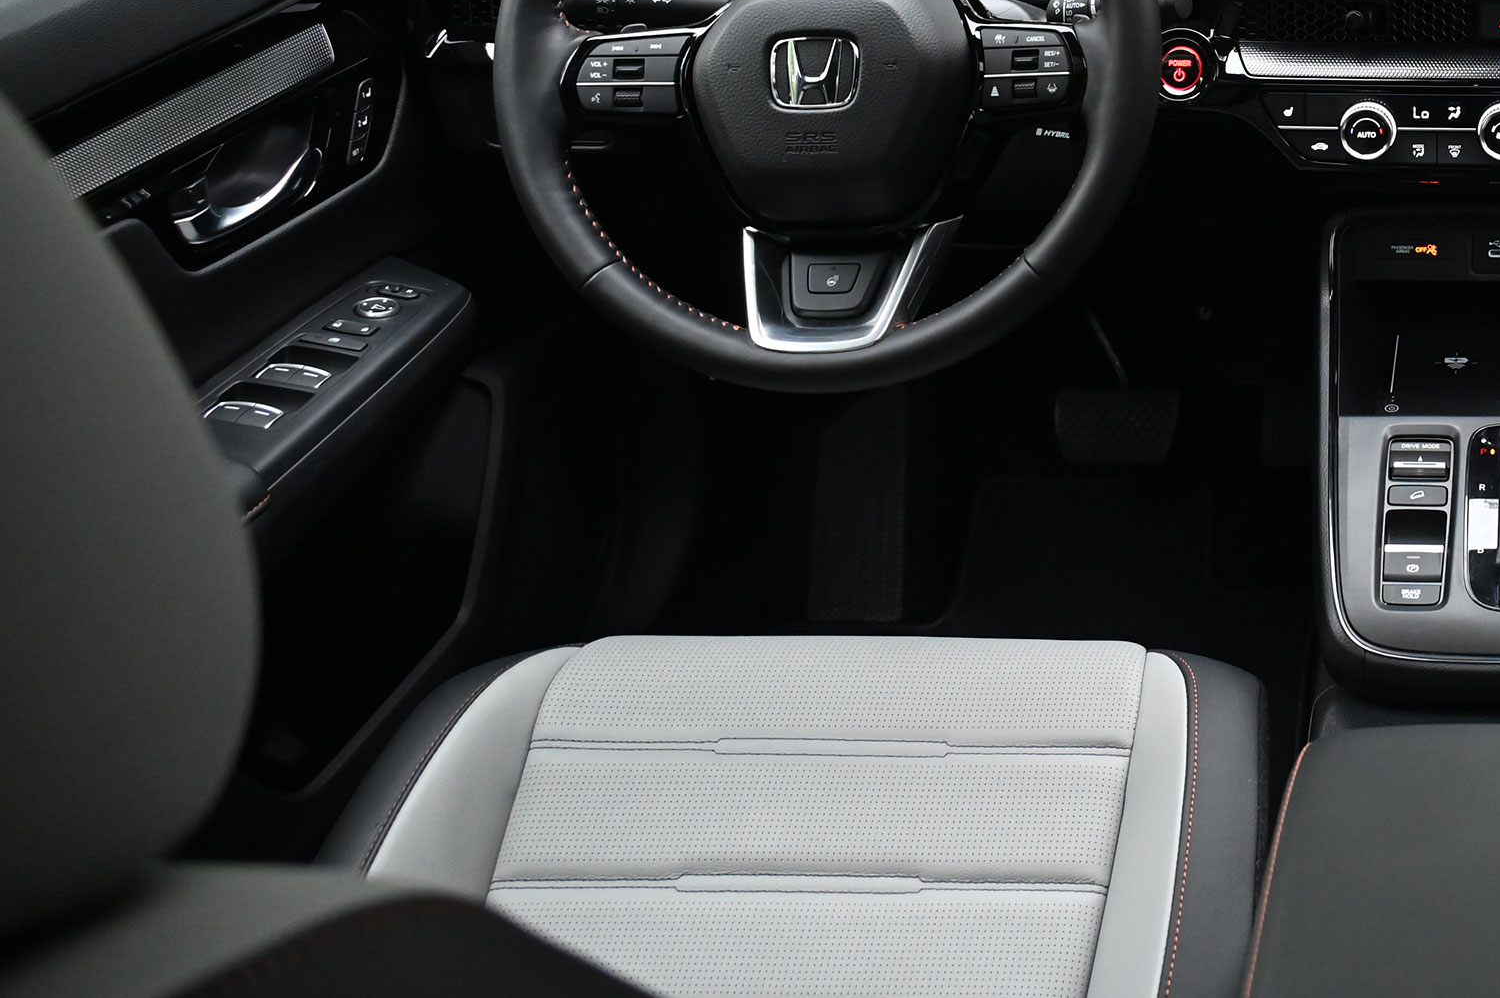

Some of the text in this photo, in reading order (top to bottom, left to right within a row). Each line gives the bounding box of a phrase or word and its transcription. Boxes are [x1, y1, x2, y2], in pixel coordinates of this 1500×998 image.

[1168, 59, 1193, 67] POWER
[1413, 106, 1430, 119] Lo
[786, 132, 838, 143] SRS
[1480, 448, 1488, 456] P
[1479, 483, 1486, 491] R
